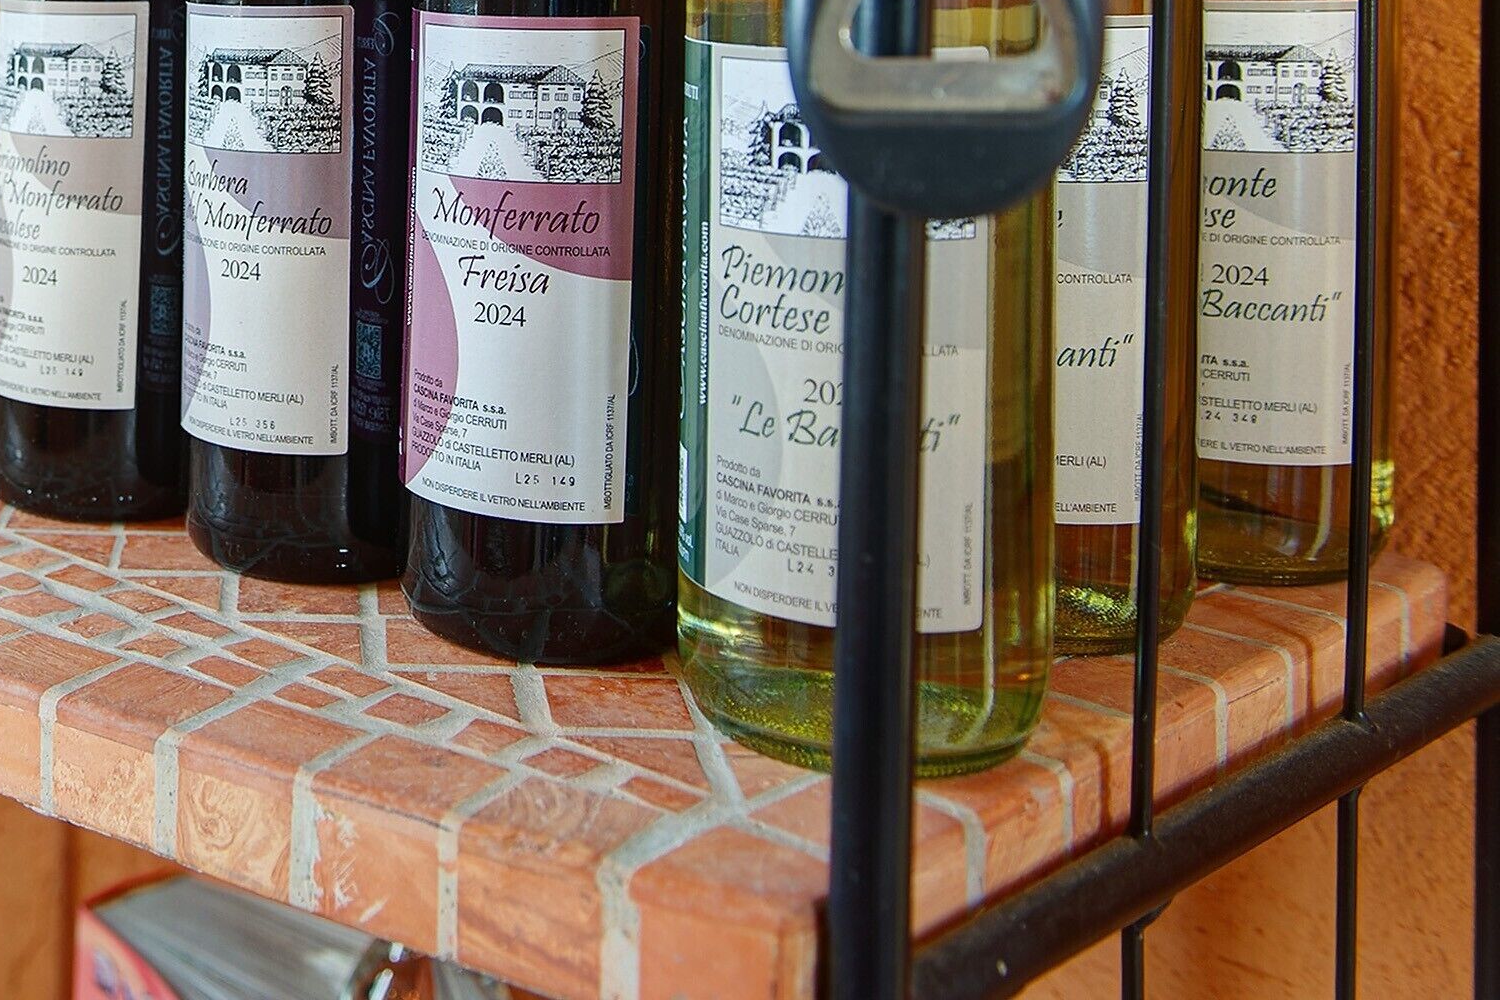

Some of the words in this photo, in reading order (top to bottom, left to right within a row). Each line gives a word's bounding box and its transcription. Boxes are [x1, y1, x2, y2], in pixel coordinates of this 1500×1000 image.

[186, 159, 250, 196] Barbera
[6, 178, 124, 216] Monferrato
[204, 199, 333, 241] Monferrato
[432, 187, 601, 241] Monferrato
[58, 246, 117, 257] CONTROLLATA
[228, 242, 260, 255] ORIGINE
[261, 244, 327, 257] CONTROLLATA
[421, 228, 478, 251] DENOMINAZIONE
[480, 240, 489, 252] DI
[491, 242, 533, 256] ORIGINE
[535, 245, 611, 258] CONTROLLATA
[1210, 233, 1221, 243] DI
[1223, 233, 1268, 246] ORIGINE
[1269, 235, 1341, 247] CONTROLLATA
[22, 264, 58, 286] 2024
[220, 257, 262, 282] 2024
[458, 254, 550, 295] Freisa
[721, 243, 845, 296] Piemon
[1056, 273, 1132, 285] CONTROLLATA
[1211, 263, 1270, 287] 2024
[473, 301, 527, 328] 2024
[699, 221, 709, 405] www.cascinafavorita.com
[719, 283, 831, 336] Cortese
[1202, 289, 1343, 323] Baccanti"
[717, 322, 798, 351] DENOMINAZIONE
[800, 339, 812, 352] DI
[1056, 333, 1134, 369] anti"
[1222, 358, 1250, 369] s.s.a.
[216, 358, 248, 374] CERRUTI
[1203, 368, 1250, 383] CERRUTI
[207, 383, 257, 401] CASTELLETTO
[257, 391, 285, 403] MERLI
[286, 392, 305, 406] (AL)
[413, 383, 438, 403] CASCINA
[439, 393, 479, 412] FAVORITA
[482, 404, 507, 416] s.s.a.
[1200, 396, 1262, 412] STELLETTO
[1264, 400, 1298, 413] MERLI
[1299, 402, 1318, 415] (AL)
[465, 413, 507, 431] CERRUTI
[1200, 410, 1222, 421] 24
[256, 433, 314, 445] NELL'AMBIENTE
[462, 427, 468, 438] 7
[452, 442, 518, 463] CASTELLETTO
[519, 451, 553, 466] MERLI
[555, 453, 575, 469] (AL)
[605, 441, 614, 453] DA
[1229, 442, 1261, 454] VETRO
[1262, 443, 1327, 456] NELL'AMBIENTE
[454, 455, 481, 473] ITALIA
[716, 454, 748, 477] Prodotto
[749, 467, 762, 480] da
[1085, 454, 1107, 469] (AL)
[515, 471, 540, 486] L25
[552, 476, 576, 488] 149
[603, 453, 613, 510] IMBOTTIGLIATO
[715, 471, 756, 493] CASCINA
[757, 482, 811, 505] FAVORITA
[435, 480, 479, 502] DISPERDERE
[487, 492, 517, 508] VETRO
[518, 497, 586, 512] NELL'AMBIENTE
[722, 490, 748, 509] Marco
[757, 498, 792, 520] Giorgio
[793, 508, 837, 527] CERRU
[1055, 501, 1117, 514] ELL'AMBIENTE
[715, 505, 728, 519] Via
[728, 509, 751, 526] Case
[751, 516, 788, 539] Sparse,
[790, 525, 796, 537] 7
[715, 522, 764, 549] GUAZZOLO
[766, 538, 775, 551] di
[776, 541, 838, 561] CASTELLE
[715, 537, 741, 559] ITALIA
[787, 558, 815, 575] L24
[733, 580, 752, 597] NON
[752, 586, 811, 610] DISPERDERE
[813, 597, 822, 611] IL
